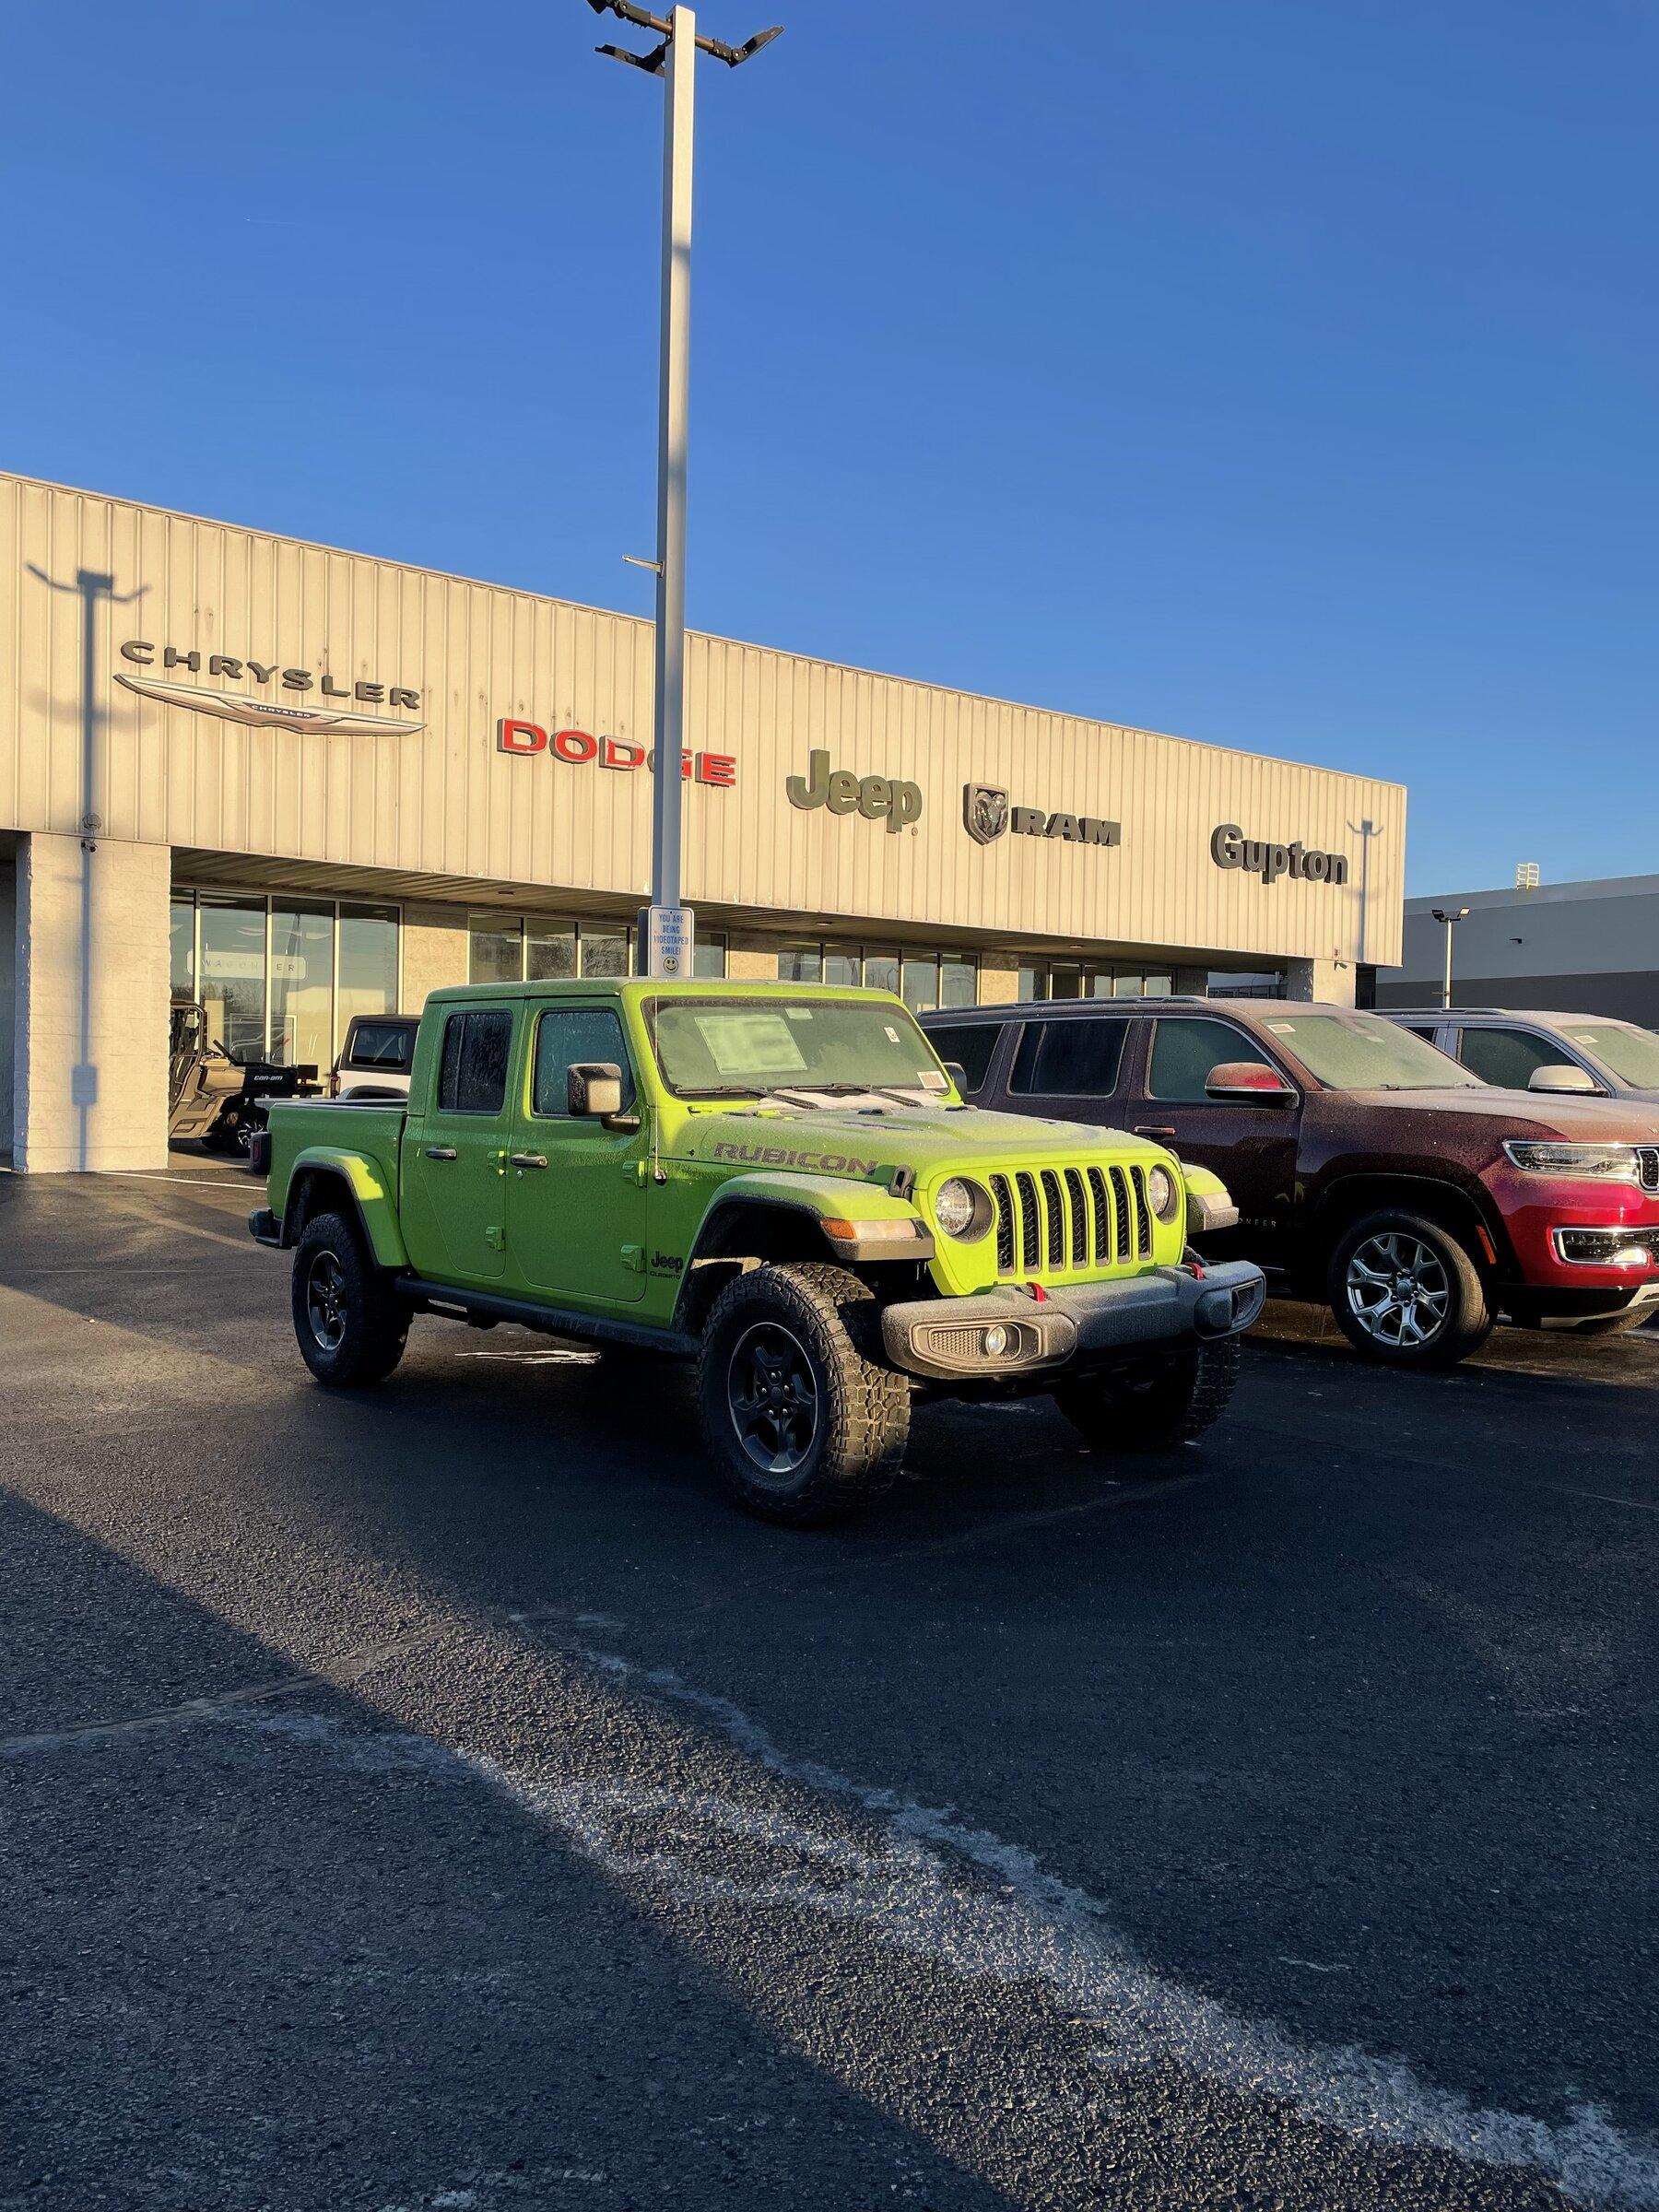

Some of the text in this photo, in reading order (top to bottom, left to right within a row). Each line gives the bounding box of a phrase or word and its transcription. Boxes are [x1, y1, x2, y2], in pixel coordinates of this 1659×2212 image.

[121, 640, 420, 709] CHRYSLER
[252, 704, 311, 718] CHRYSLER
[785, 749, 923, 834] Jeep
[1011, 806, 1121, 846] RAM
[1210, 823, 1348, 885] Gupton
[658, 913, 684, 924] YOU ARE
[662, 924, 680, 934] BEING
[202, 959, 295, 971] WAGONER
[713, 1142, 879, 1175] RUBICON
[651, 1251, 683, 1273] Jeep
